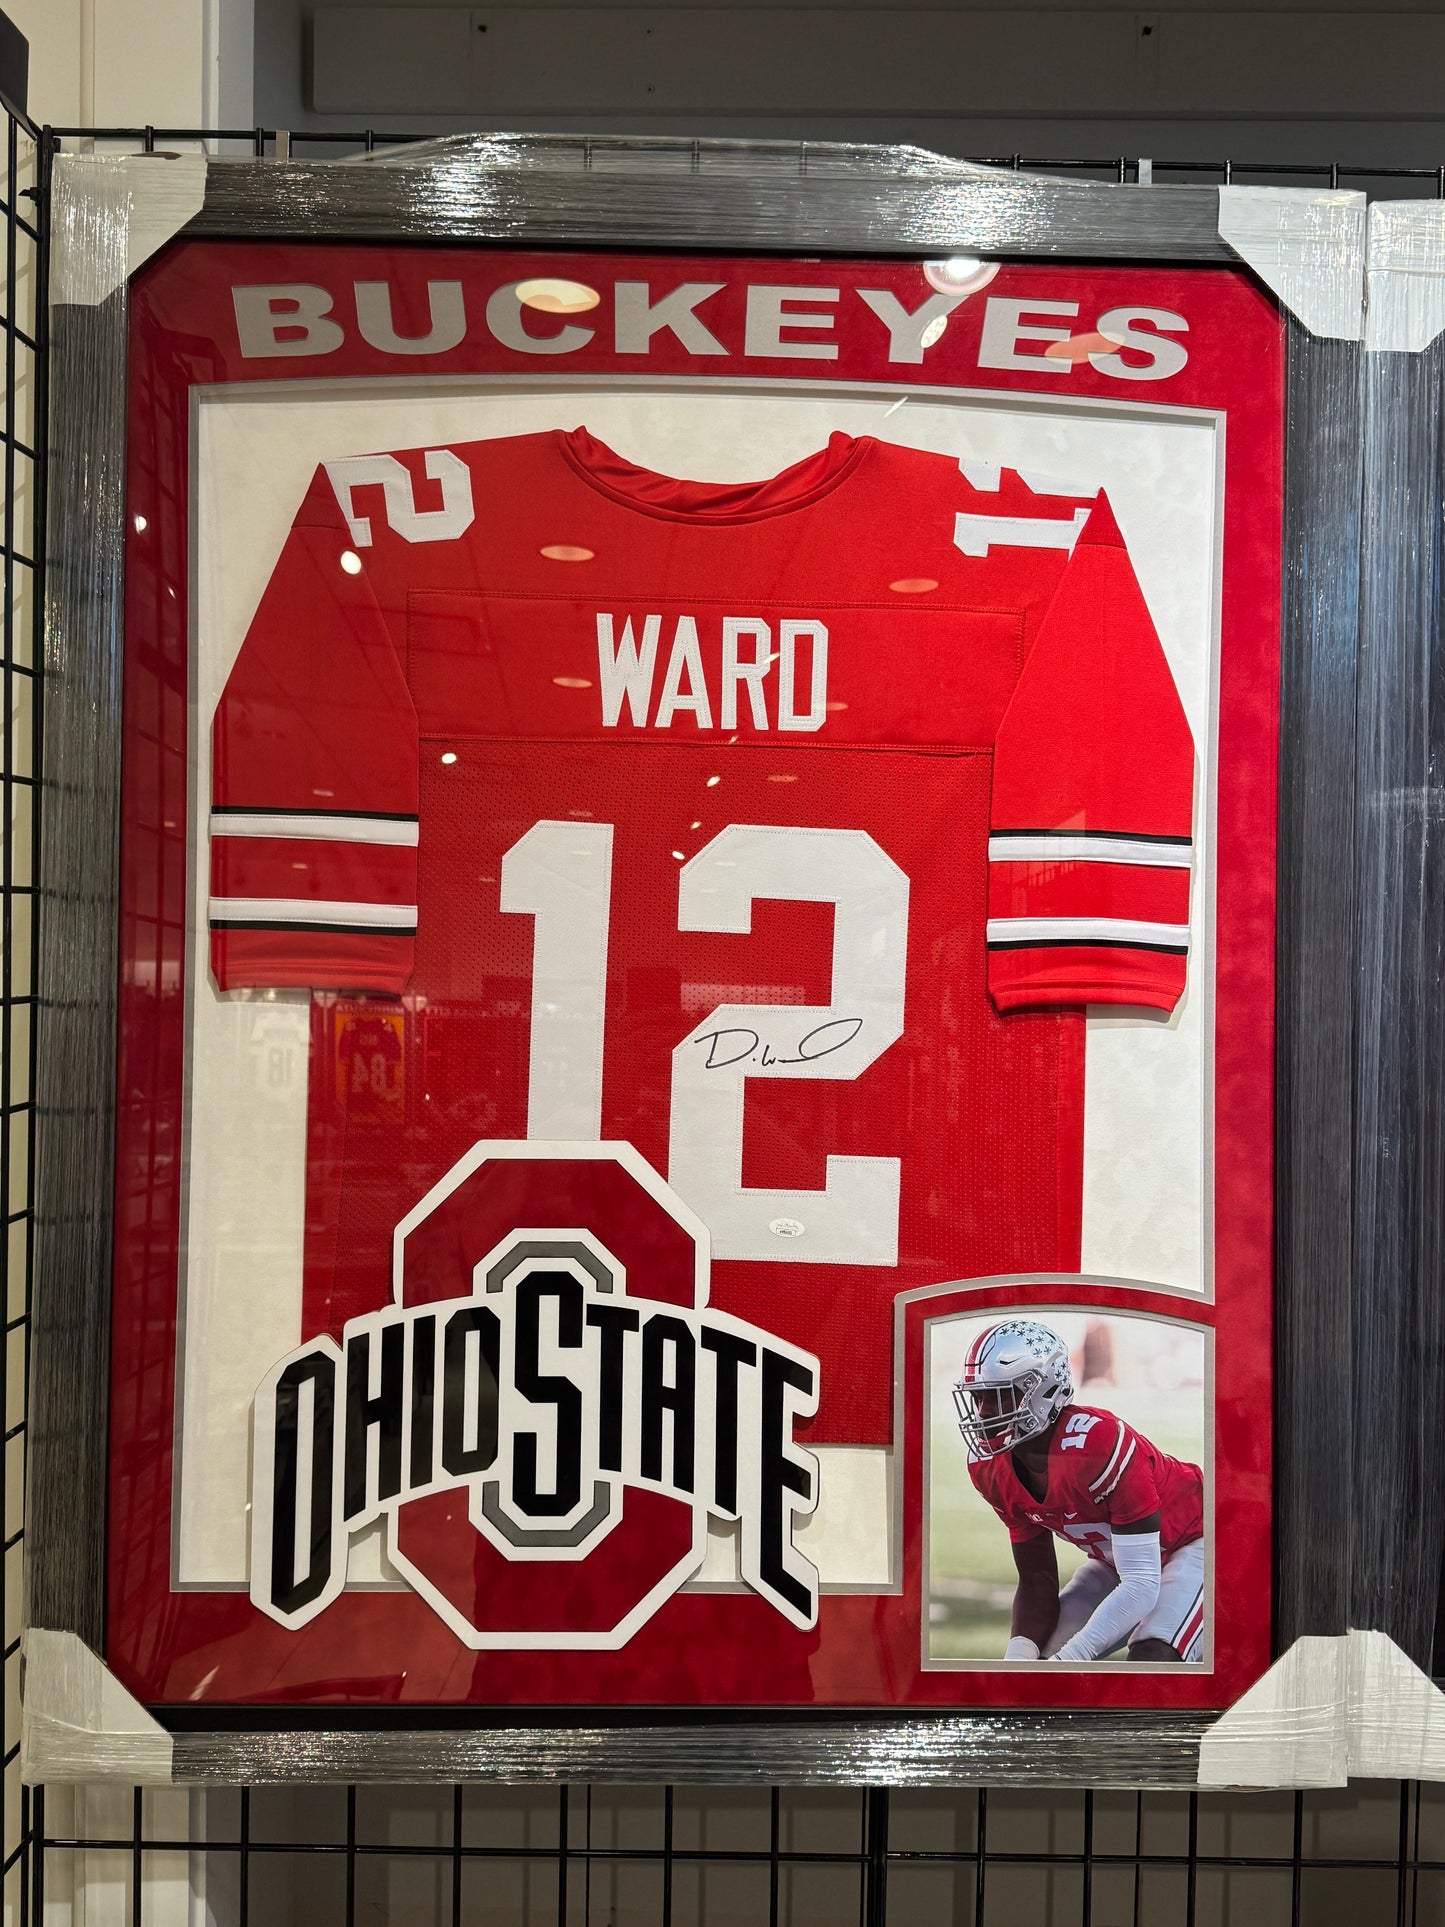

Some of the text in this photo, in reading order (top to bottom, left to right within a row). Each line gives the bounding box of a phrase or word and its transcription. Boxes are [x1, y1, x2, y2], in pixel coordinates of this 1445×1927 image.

[231, 278, 1190, 381] BUCKEYES
[596, 612, 829, 732] WARD
[499, 819, 911, 1267] 12
[270, 1270, 814, 1622] OHIO STATE
[1060, 1412, 1103, 1451] 12
